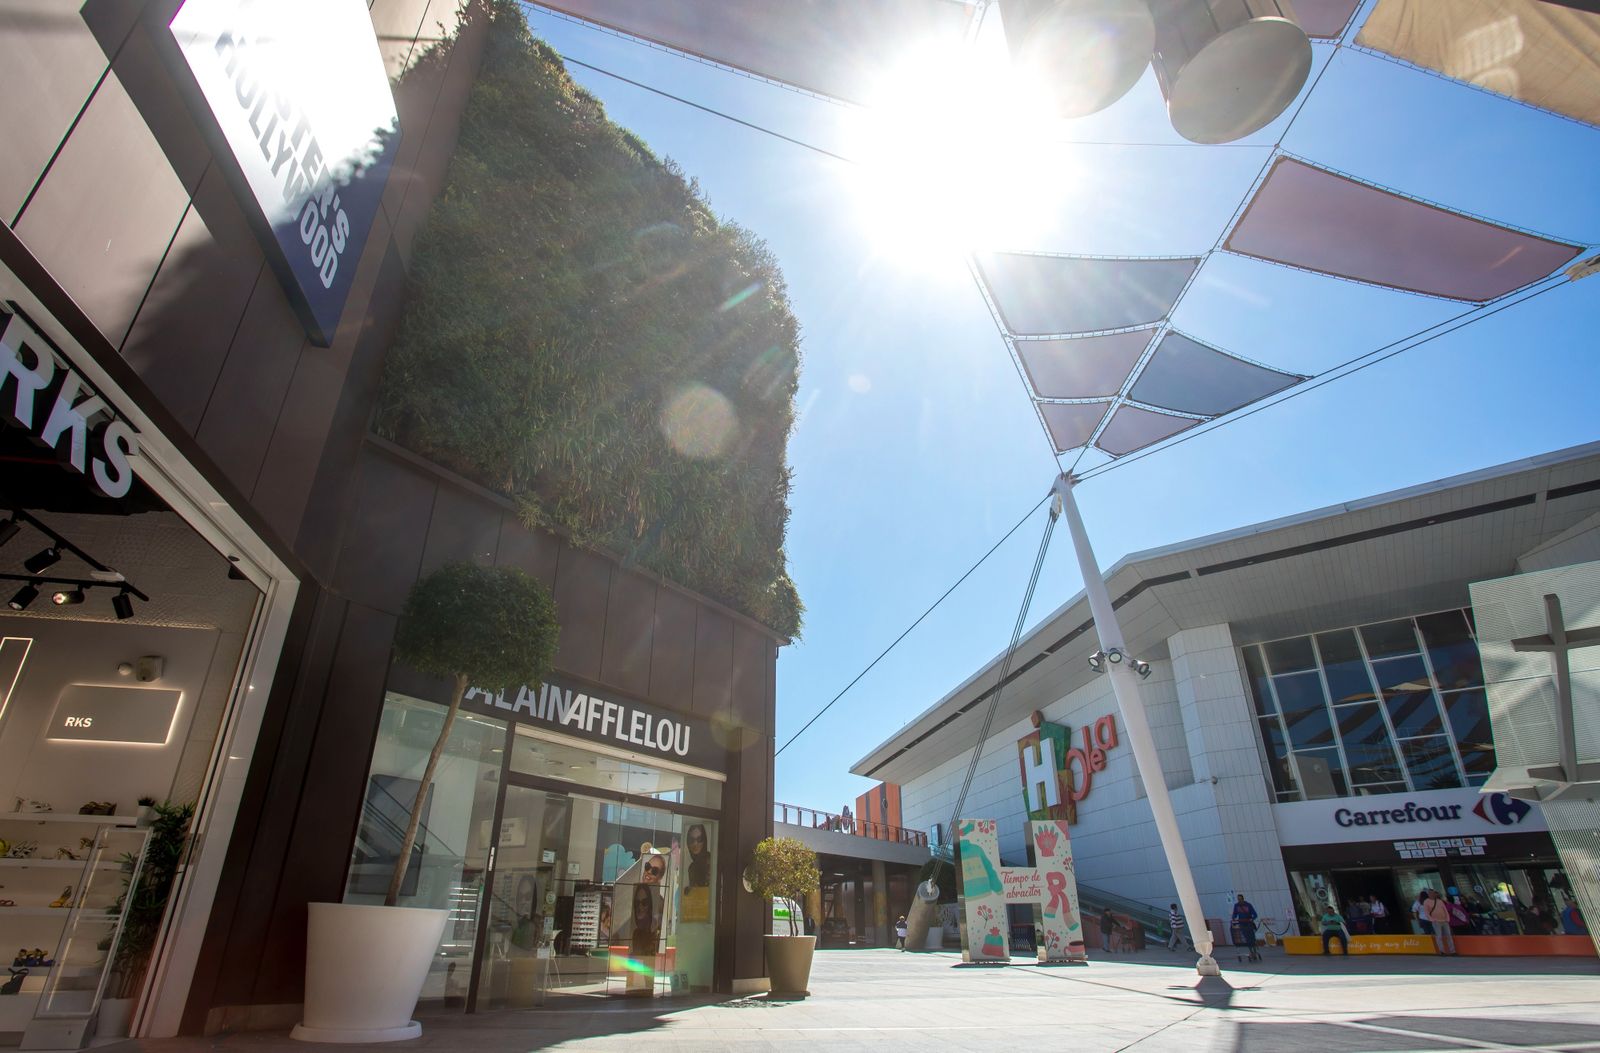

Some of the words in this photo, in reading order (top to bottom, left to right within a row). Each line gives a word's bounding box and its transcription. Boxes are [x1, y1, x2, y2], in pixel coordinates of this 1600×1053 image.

[0, 313, 139, 499] RKS
[64, 716, 93, 728] RKS
[562, 693, 691, 756] AFFLELOU
[1334, 802, 1462, 827] Carrefour
[1001, 871, 1029, 888] Tiempo
[1032, 869, 1041, 881] de
